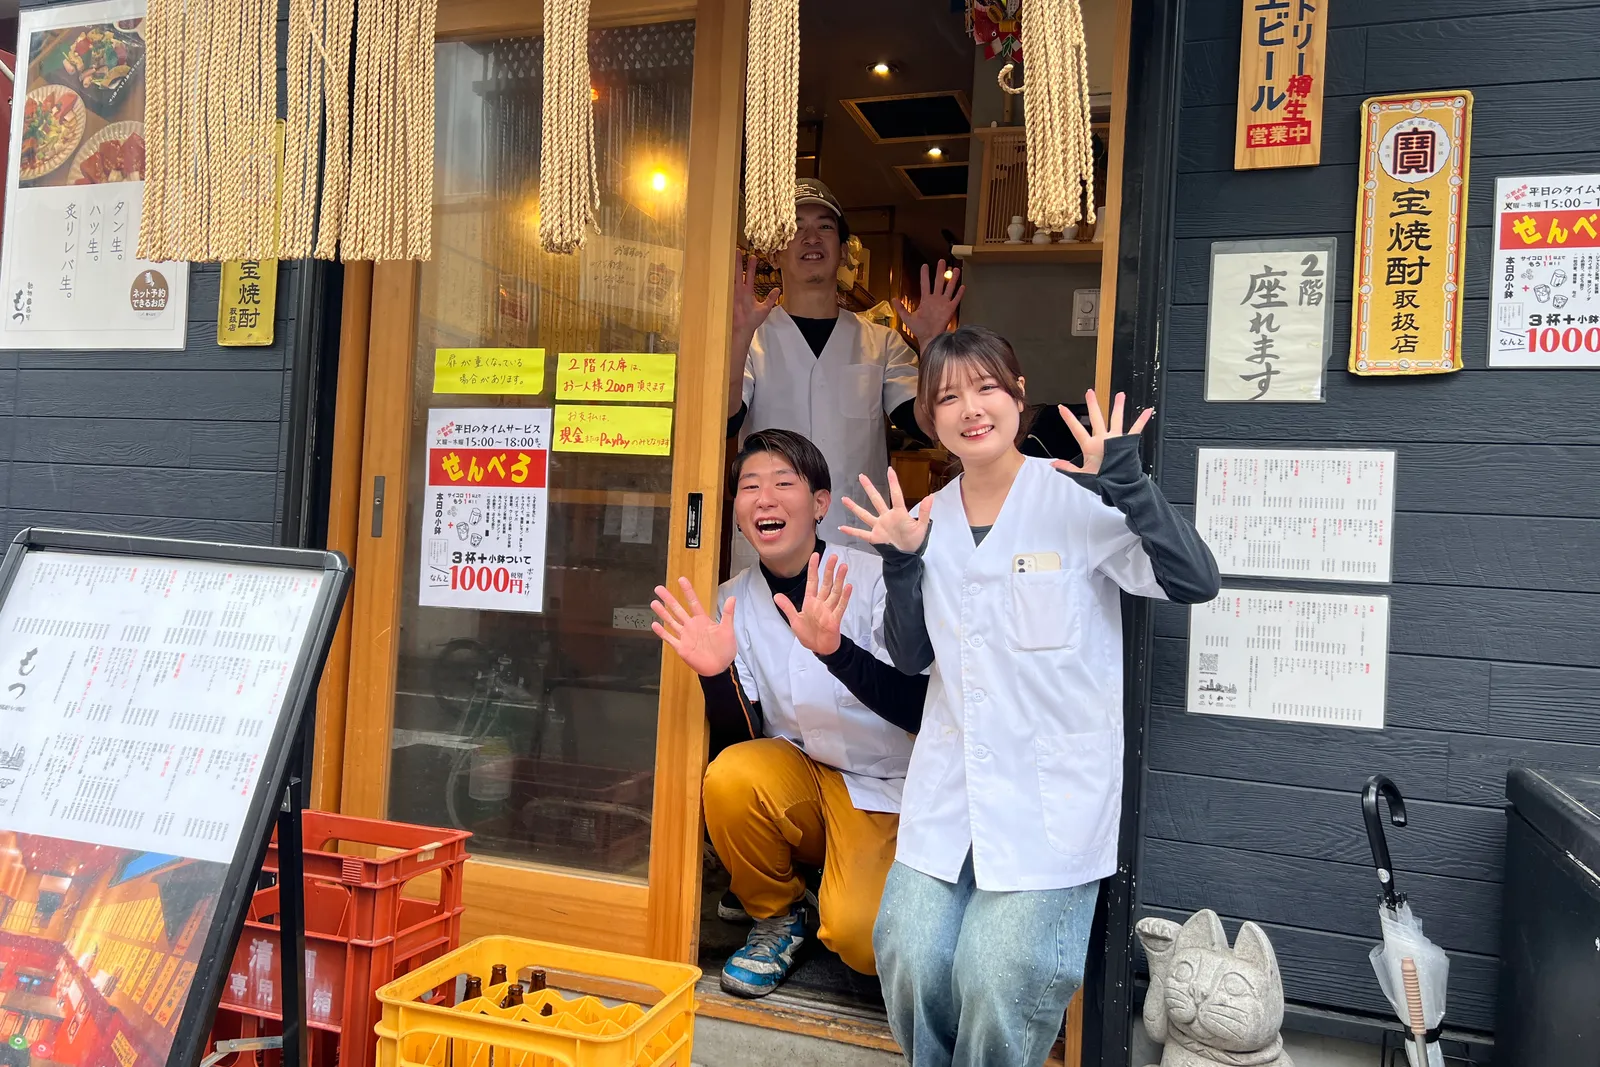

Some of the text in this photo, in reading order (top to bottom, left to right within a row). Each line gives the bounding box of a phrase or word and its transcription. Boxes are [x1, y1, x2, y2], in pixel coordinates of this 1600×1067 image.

[1282, 74, 1314, 122] 樽生
[1249, 123, 1309, 146] 営業中
[86, 205, 101, 261] ハツ生。
[110, 201, 125, 261] タン生。
[1512, 213, 1598, 245] せんべ
[59, 202, 78, 298] 炙りレバ生。
[132, 288, 166, 299] ネット予約
[238, 260, 261, 328] 宝焼酎
[1298, 253, 1325, 307] 2階
[1504, 256, 1516, 299] 本日の小鉢
[132, 298, 166, 308] できるお店
[1239, 264, 1289, 400] 座れます
[1500, 327, 1600, 353] なんと 1000
[446, 353, 523, 368] 扉が重くなっている
[459, 373, 524, 385] 場合があります。
[454, 423, 541, 434] 平日のタイムサービス
[441, 451, 532, 484] せんべろ
[433, 492, 444, 535] 本日の小鉢
[430, 574, 448, 582] なんと
